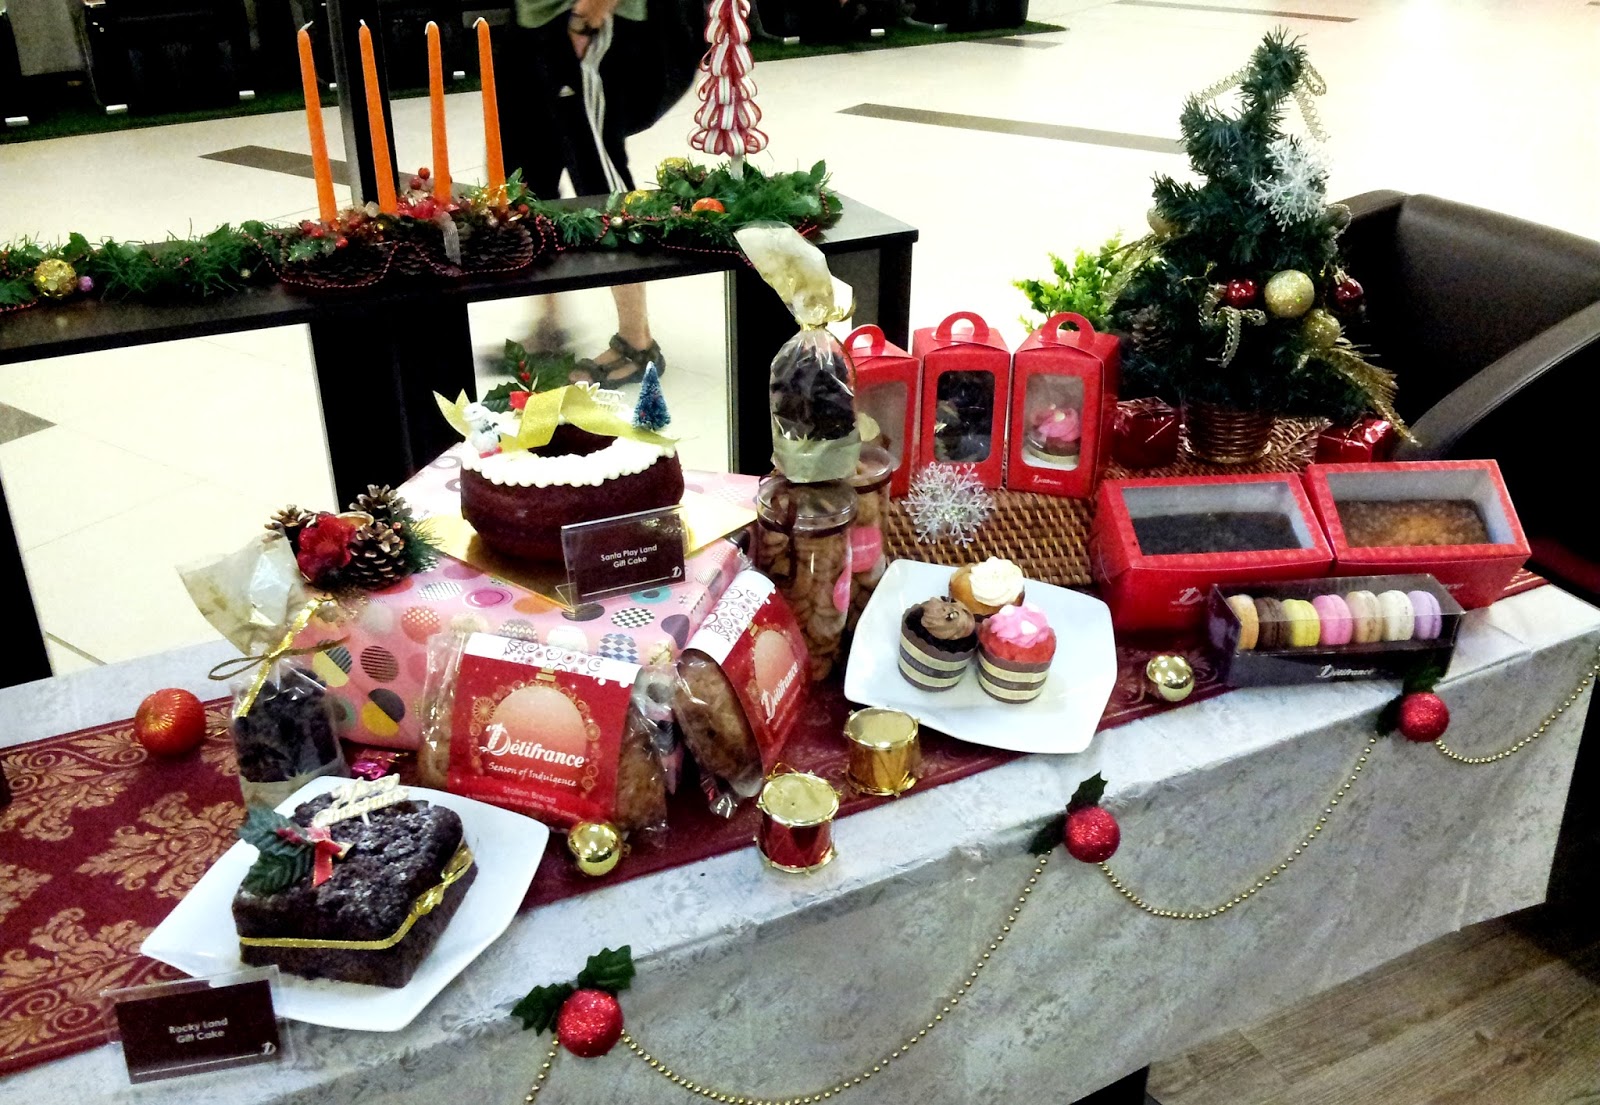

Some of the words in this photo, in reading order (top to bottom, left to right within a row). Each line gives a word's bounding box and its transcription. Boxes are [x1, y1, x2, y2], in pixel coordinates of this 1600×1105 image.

[600, 552, 622, 561] Santa
[623, 549, 639, 558] Play
[640, 544, 657, 554] Land
[613, 560, 627, 568] Gift
[627, 556, 647, 566] Cake
[479, 722, 585, 768] Délifrance
[488, 761, 517, 775] Season
[518, 769, 527, 780] of
[531, 791, 557, 804] Bread
[168, 1022, 200, 1034] Rocky
[203, 1017, 228, 1028] Land
[176, 1034, 195, 1043] Gift
[197, 1030, 225, 1040] Cake
